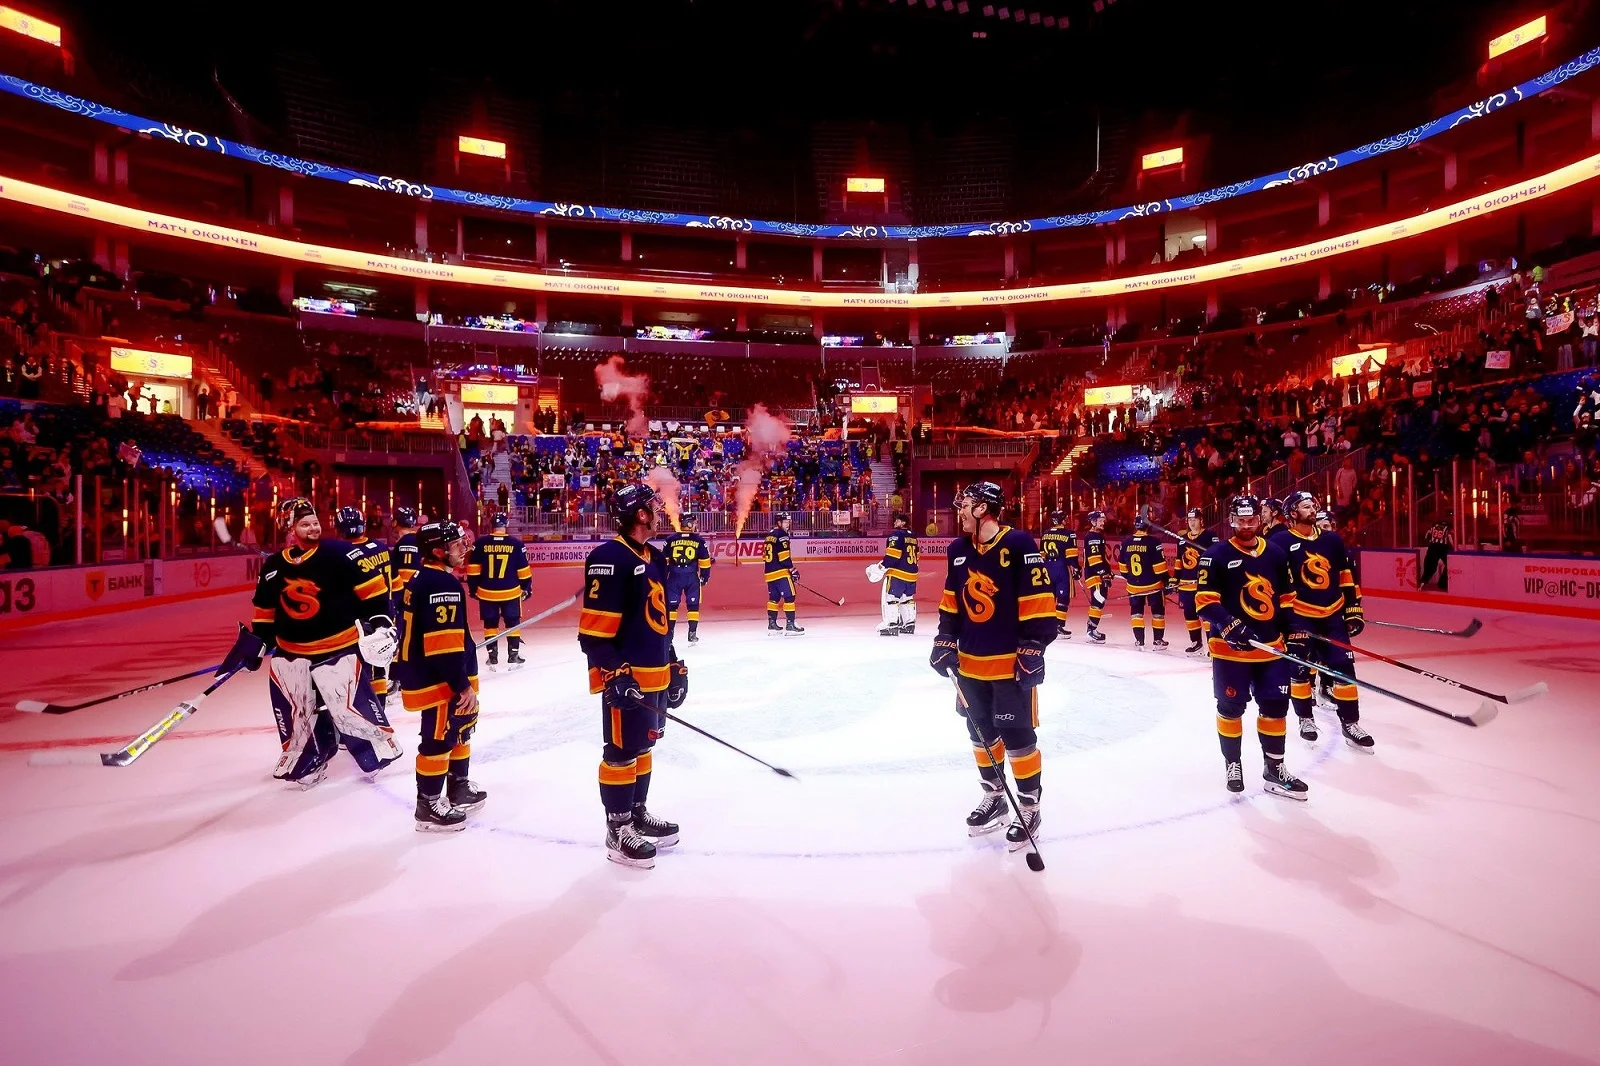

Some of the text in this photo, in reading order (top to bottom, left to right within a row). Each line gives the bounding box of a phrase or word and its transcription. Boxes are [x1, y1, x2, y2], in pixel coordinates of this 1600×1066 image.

[1450, 184, 1546, 219] МАТЧ ОКОНЧЕН
[148, 219, 258, 247] МАТЧ ОКОНЧЕН
[1280, 239, 1359, 262] МАТЧ ОКОНЧЕН
[367, 260, 454, 278] МАТЧ ОКОНЧЕН
[574, 283, 620, 291] ОКОНЧЕН
[1125, 274, 1196, 289] МАТЧ ОКОНЧЕН
[1008, 292, 1048, 300] ОКОНЧЕН
[484, 544, 514, 554] SOLOVYOV
[670, 539, 700, 548] ALEXANDROV
[714, 542, 764, 557] FONB
[806, 545, 879, 556] VIP@HC-DRAGONS.COM
[488, 554, 509, 578] 17
[1000, 548, 1010, 568] C
[1130, 554, 1142, 576] 6
[108, 574, 142, 591] БАНК
[1031, 567, 1051, 586] 23
[589, 579, 600, 598] 2
[436, 606, 457, 624] 37
